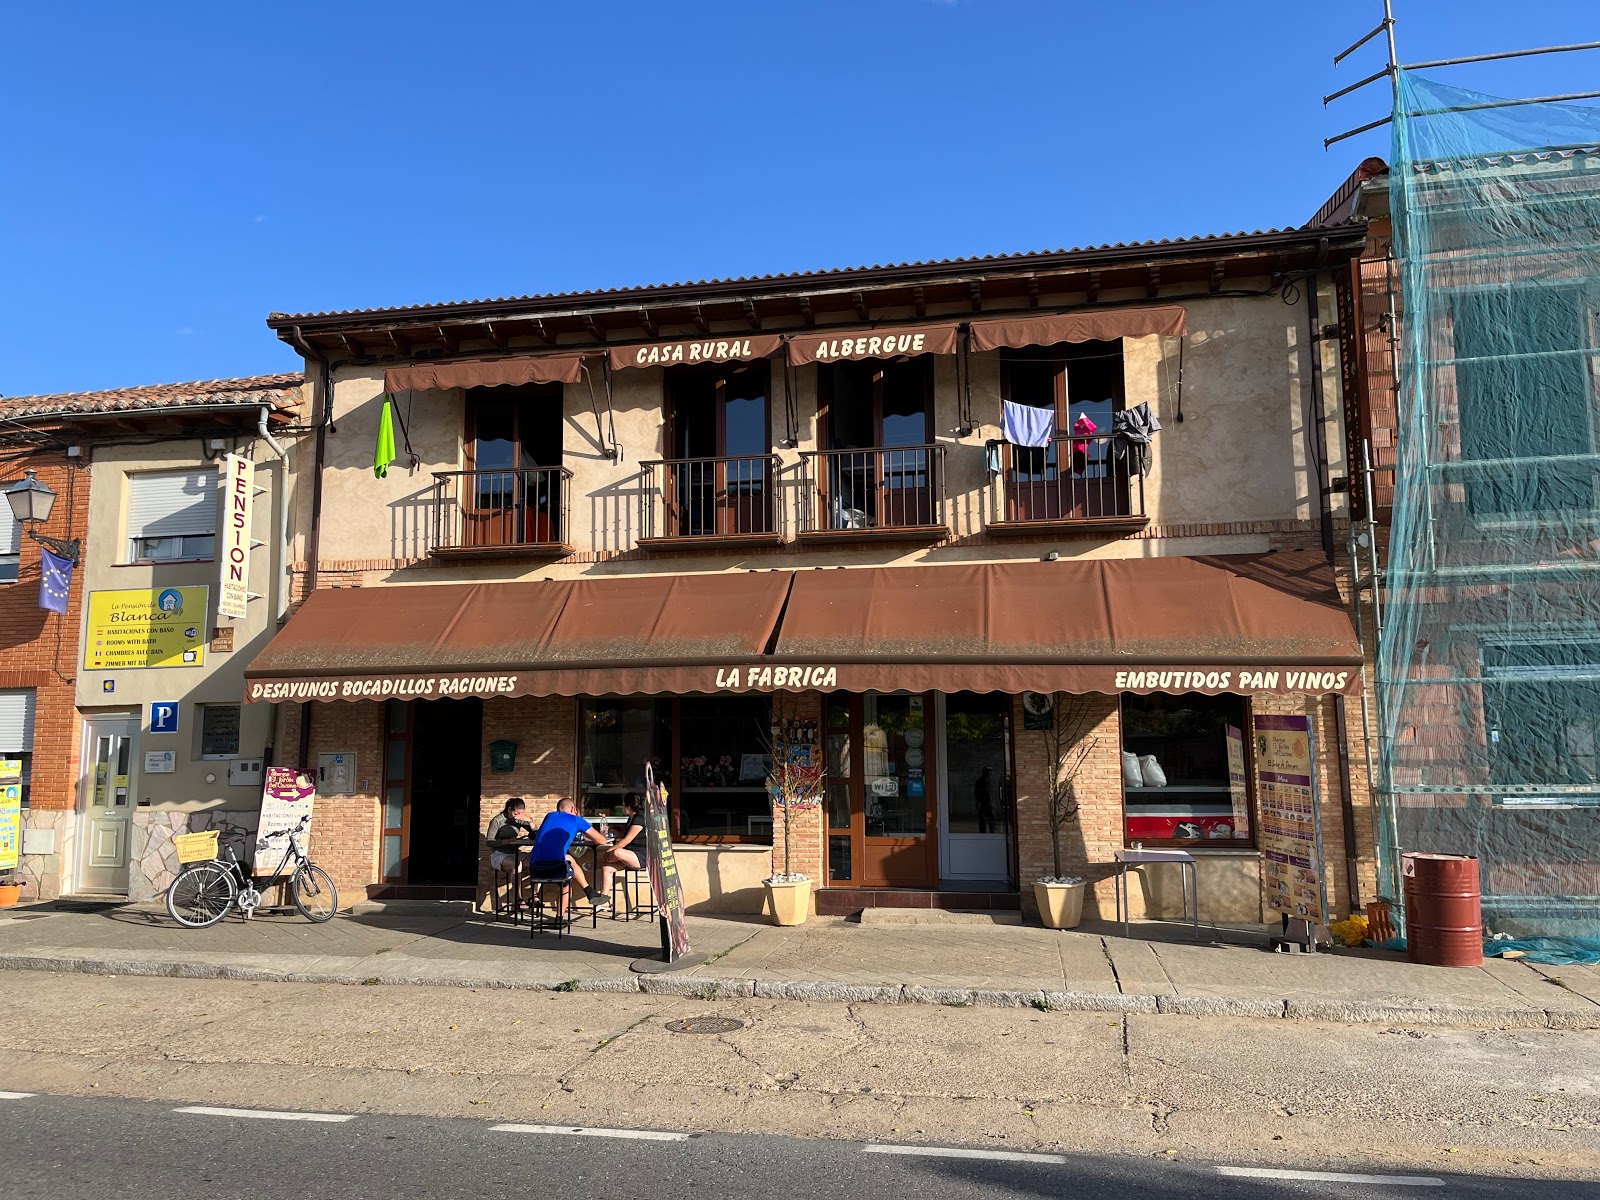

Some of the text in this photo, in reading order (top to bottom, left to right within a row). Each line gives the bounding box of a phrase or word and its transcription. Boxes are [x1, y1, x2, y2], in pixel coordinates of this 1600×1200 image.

[636, 340, 752, 364] CASA RURAL
[815, 333, 926, 359] ALBERGUE
[230, 460, 247, 582] PENSION
[110, 611, 172, 623] Blanca
[111, 602, 119, 610] La
[106, 627, 146, 635] HABITACIONES
[150, 648, 164, 656] BAIN
[251, 675, 518, 699] DESAYUNOS BOCADILLOS RACIONES
[715, 666, 837, 688] LA FABRICA
[1115, 671, 1348, 690] EMBUTIDOS PAN VINOS
[156, 706, 172, 728] P
